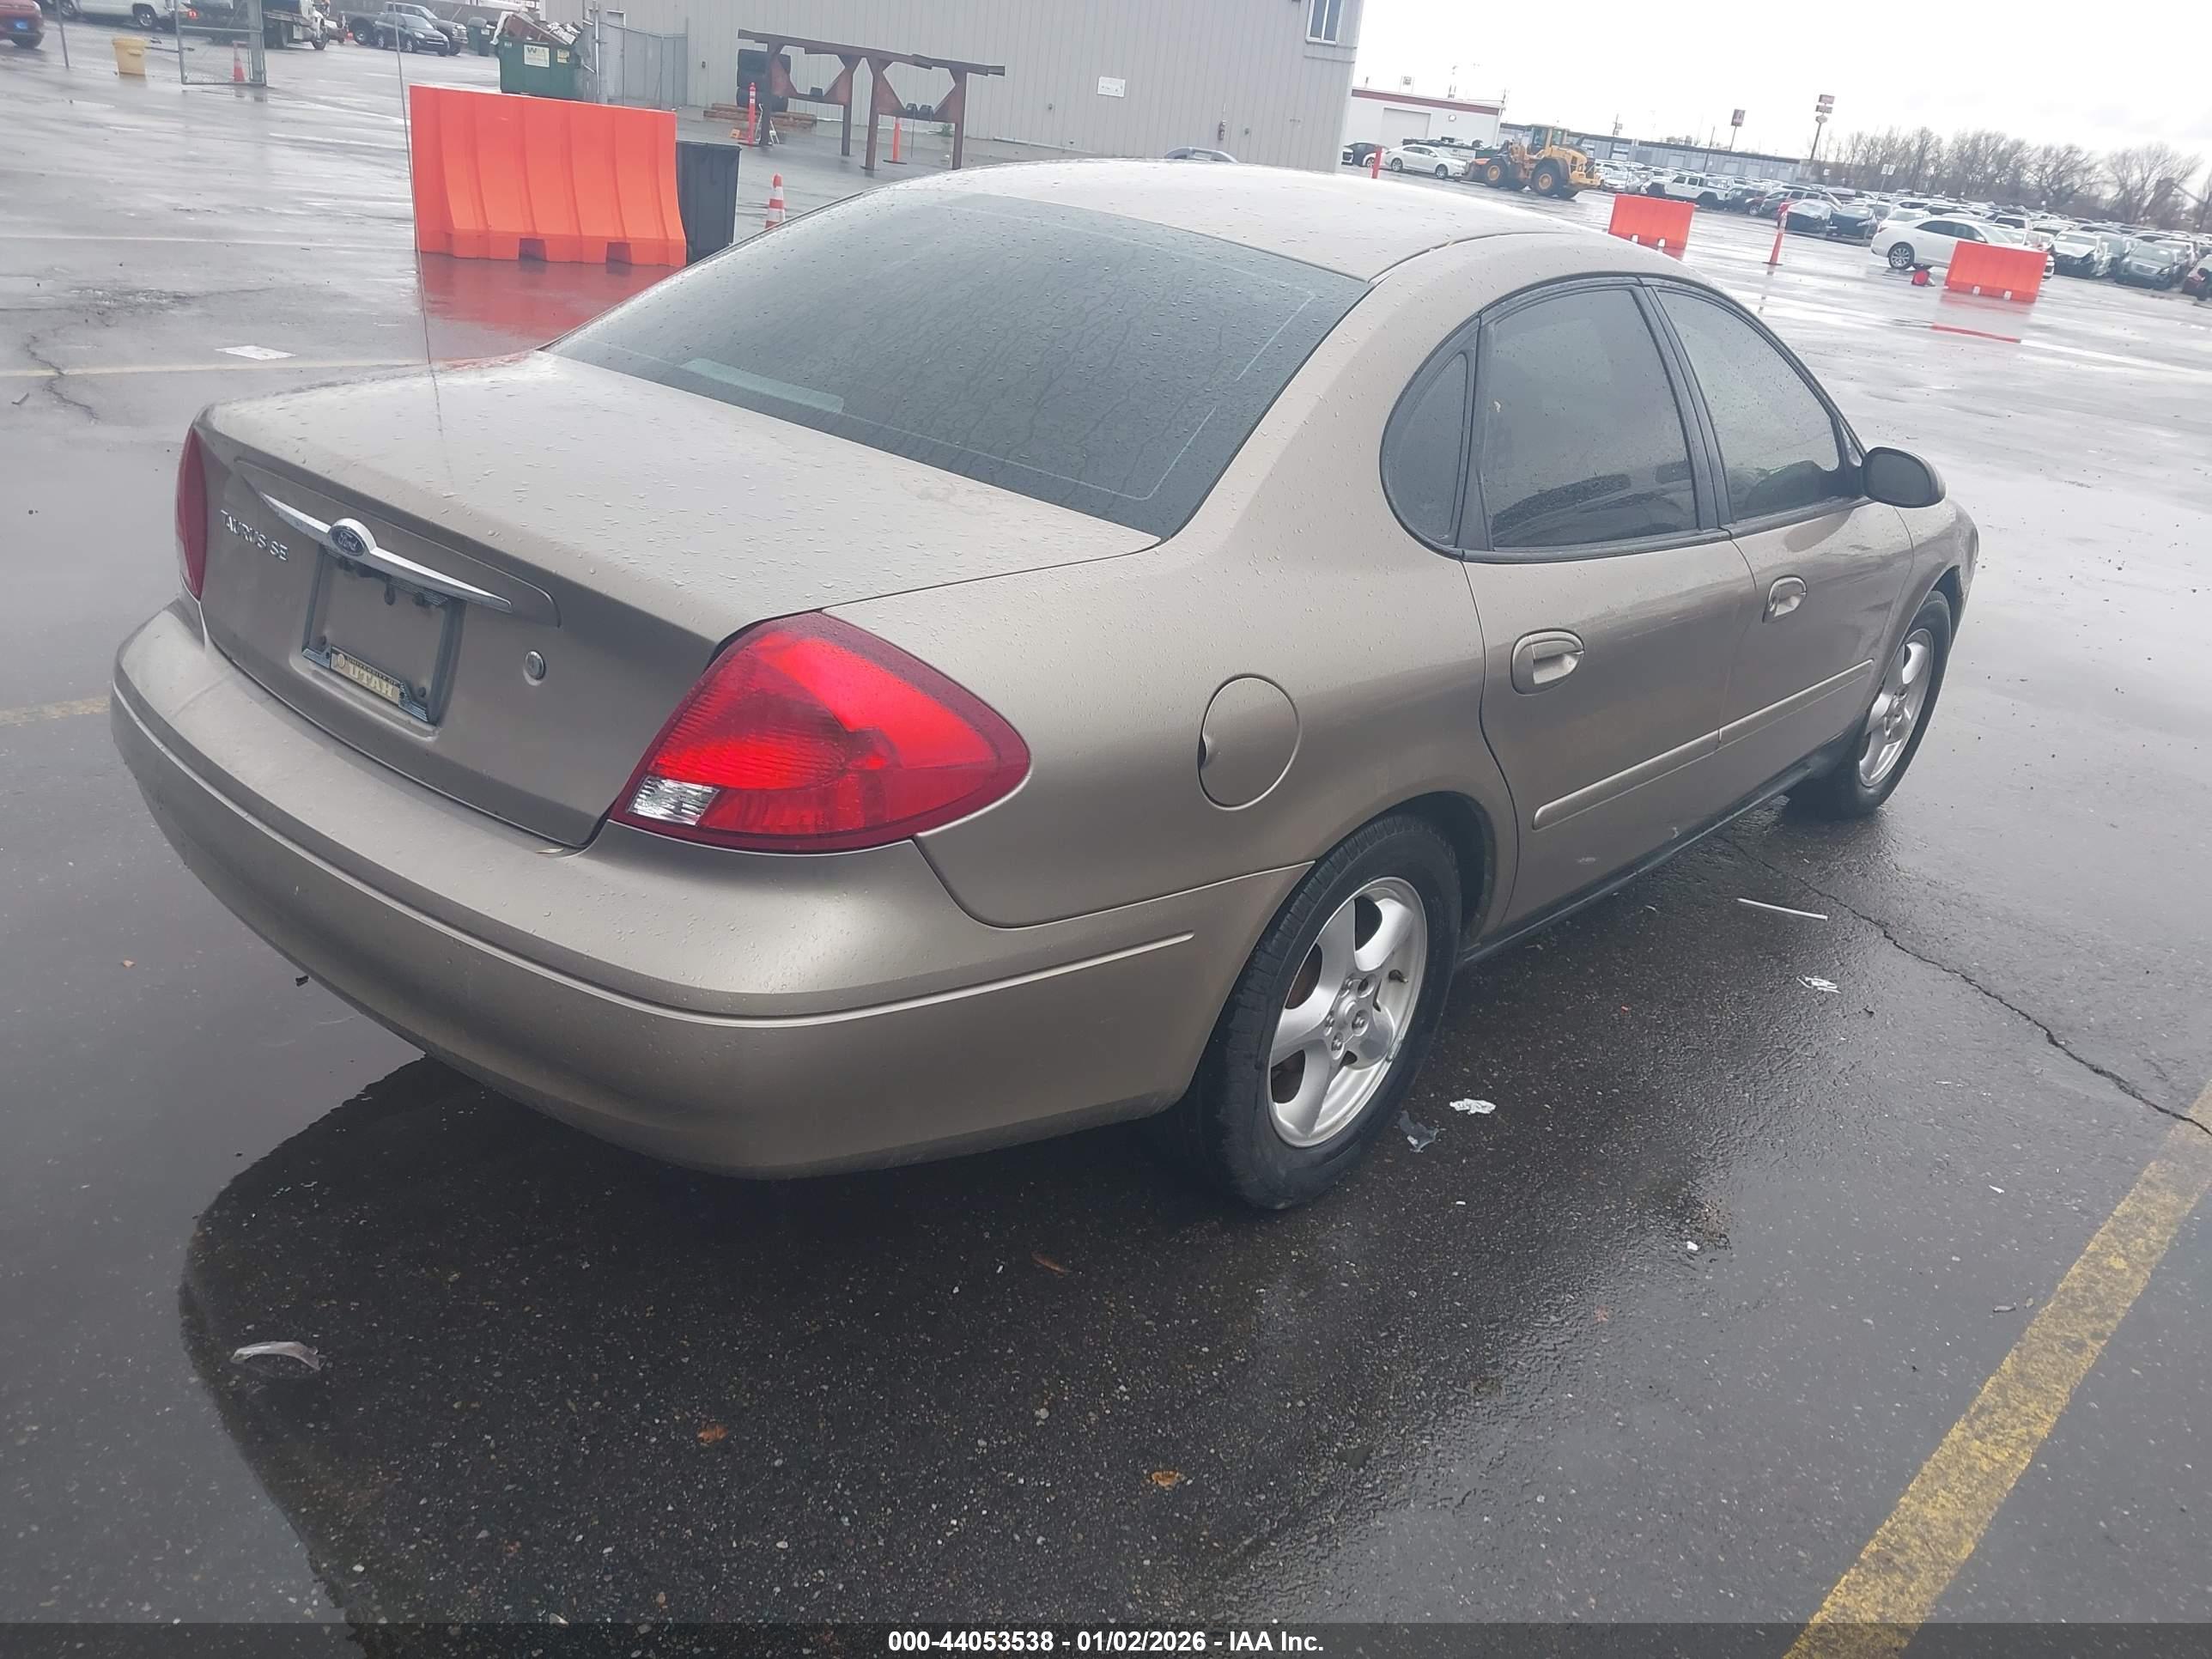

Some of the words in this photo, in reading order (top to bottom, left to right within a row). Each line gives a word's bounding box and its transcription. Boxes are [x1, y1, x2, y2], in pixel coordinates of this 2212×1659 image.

[220, 509, 267, 550] TAURUS
[270, 540, 289, 562] SE
[349, 664, 393, 698] UTAH
